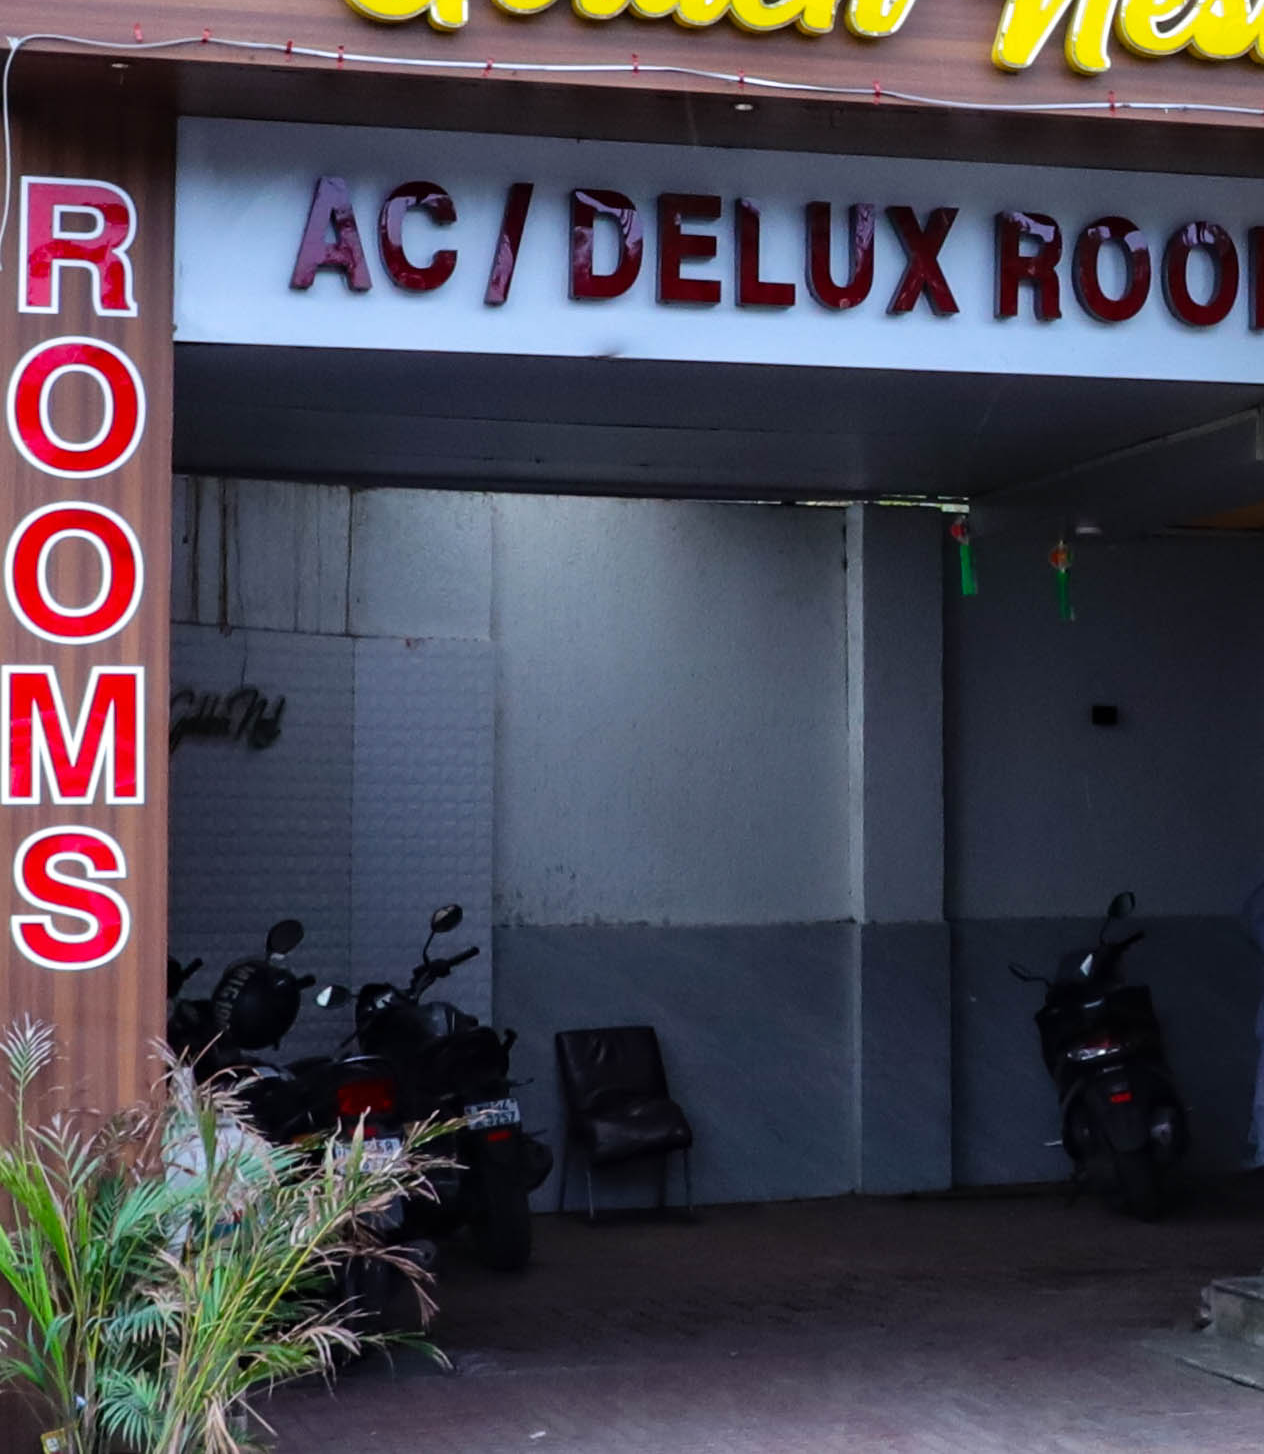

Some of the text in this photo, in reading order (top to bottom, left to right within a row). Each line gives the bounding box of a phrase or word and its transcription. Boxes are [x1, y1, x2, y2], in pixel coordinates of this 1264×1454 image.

[289, 176, 460, 294] AC
[567, 187, 961, 318] DELUX
[0, 176, 147, 971] ROOMS
